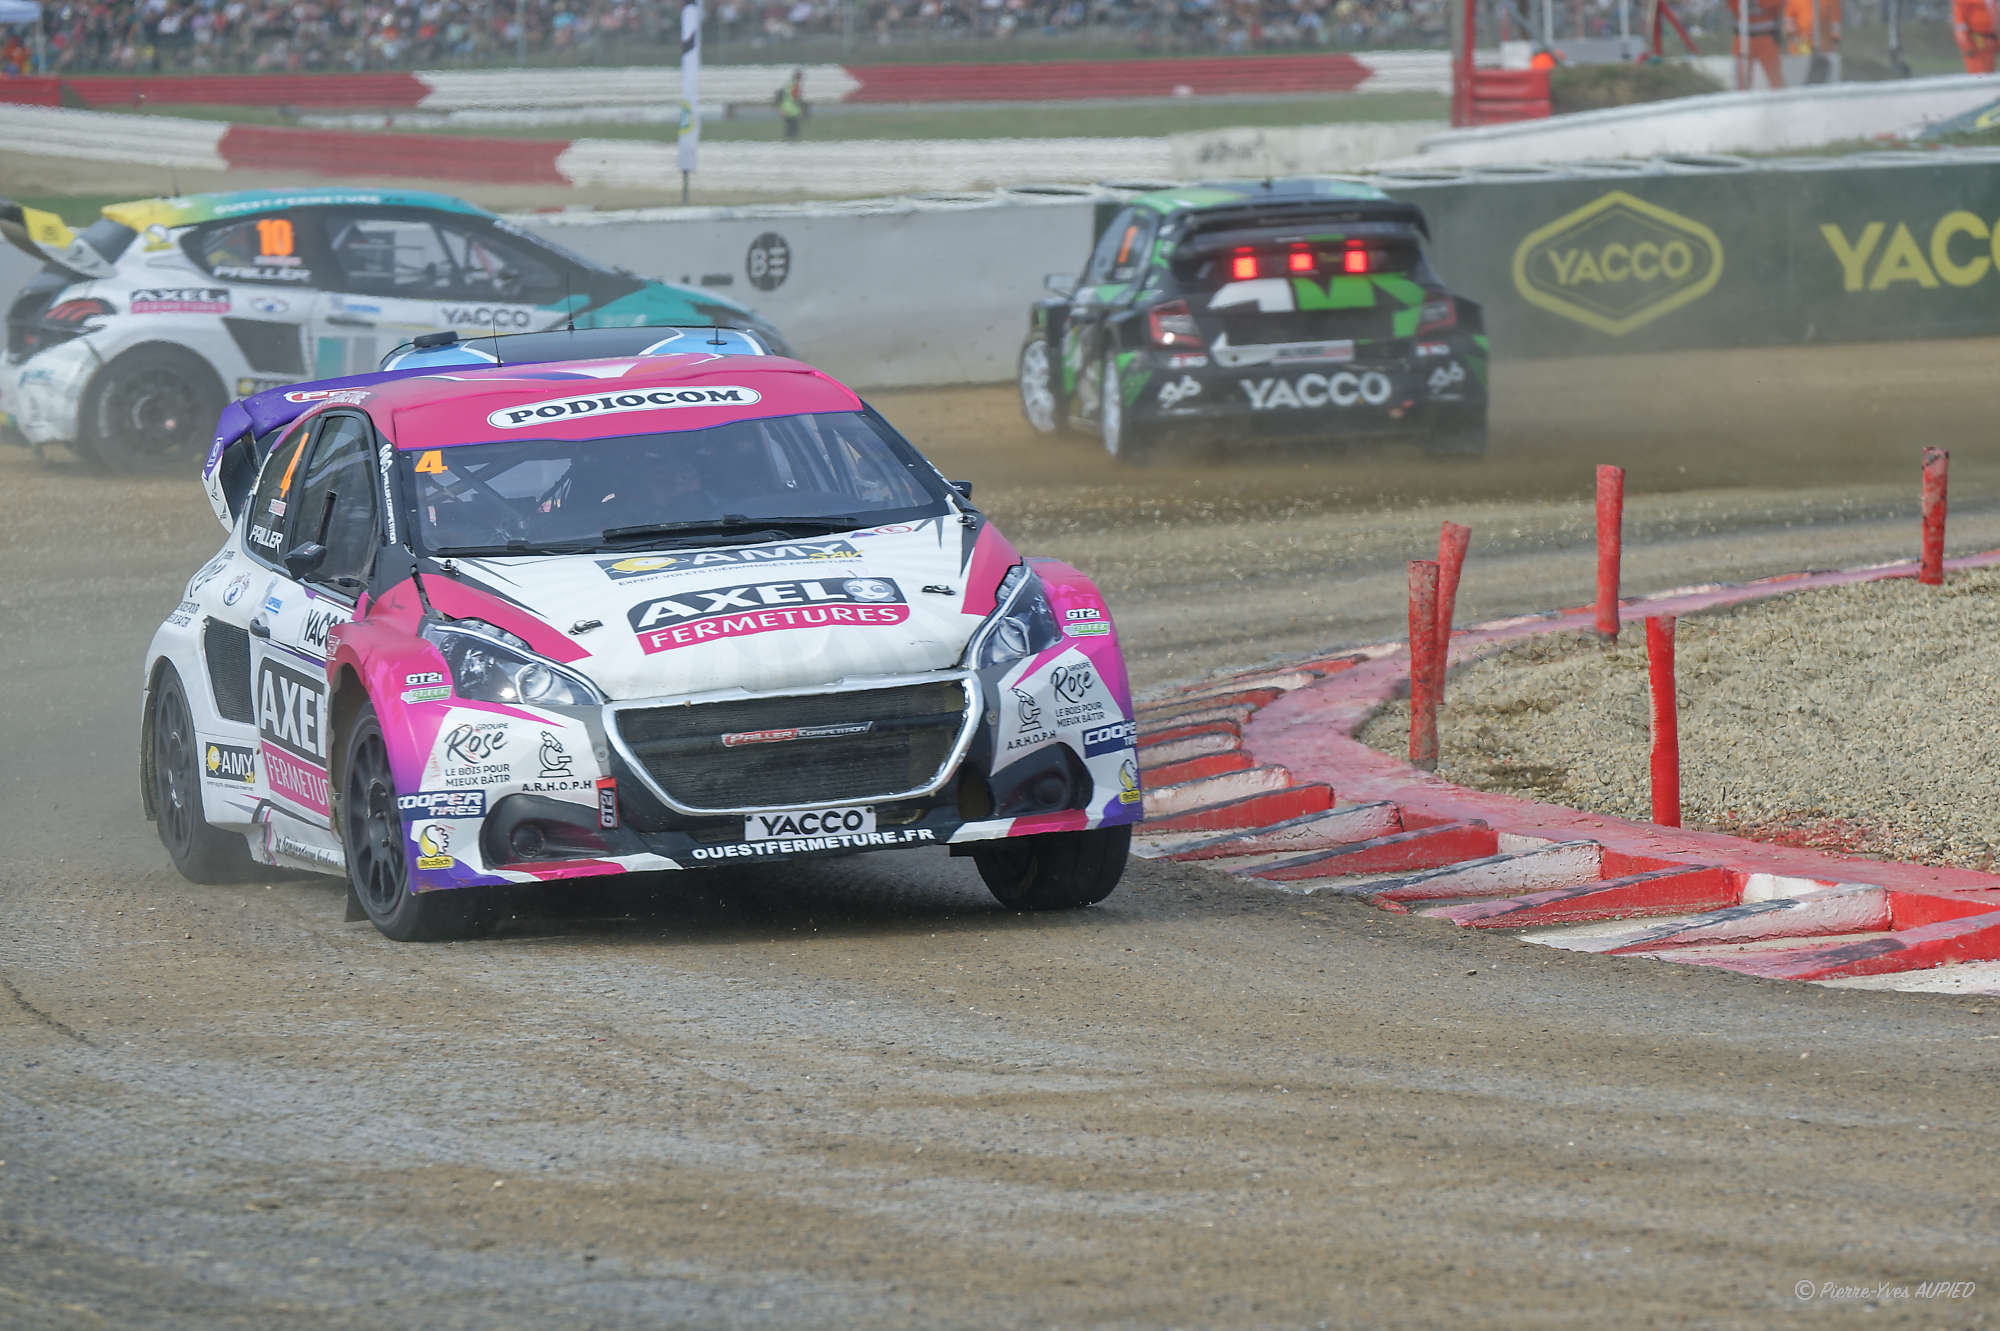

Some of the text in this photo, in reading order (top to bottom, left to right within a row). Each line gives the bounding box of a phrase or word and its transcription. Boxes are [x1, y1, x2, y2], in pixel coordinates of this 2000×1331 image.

[256, 219, 293, 256] 10
[751, 246, 786, 278] BE
[1547, 240, 1693, 286] YACCO
[1819, 210, 2000, 292] YAC
[133, 288, 218, 302] AXEL
[441, 307, 530, 327] YACCO
[1240, 371, 1392, 410] YACCO
[506, 389, 743, 424] PODIOCOM
[415, 450, 449, 474] 4
[692, 543, 844, 565] AMY
[809, 550, 865, 561] SAV
[638, 581, 848, 629] AXEL
[651, 609, 900, 648] FERMETURES
[1050, 666, 1095, 703] Rose
[1082, 701, 1103, 712] POUR
[475, 722, 509, 731] GROUPE
[1056, 716, 1081, 728] MIEUX
[444, 724, 509, 764] Rose
[1007, 730, 1057, 751] A.R.H.O.P.H
[221, 750, 253, 777] AMY
[445, 763, 510, 777] LE BOIS POUR
[446, 773, 511, 787] MIEUX BÂTIR
[522, 780, 592, 792] A.R.H.O.P.H
[427, 805, 482, 816] TIRES
[760, 810, 863, 836] YACCO
[691, 828, 936, 860] OUESTFERMETURE.FR
